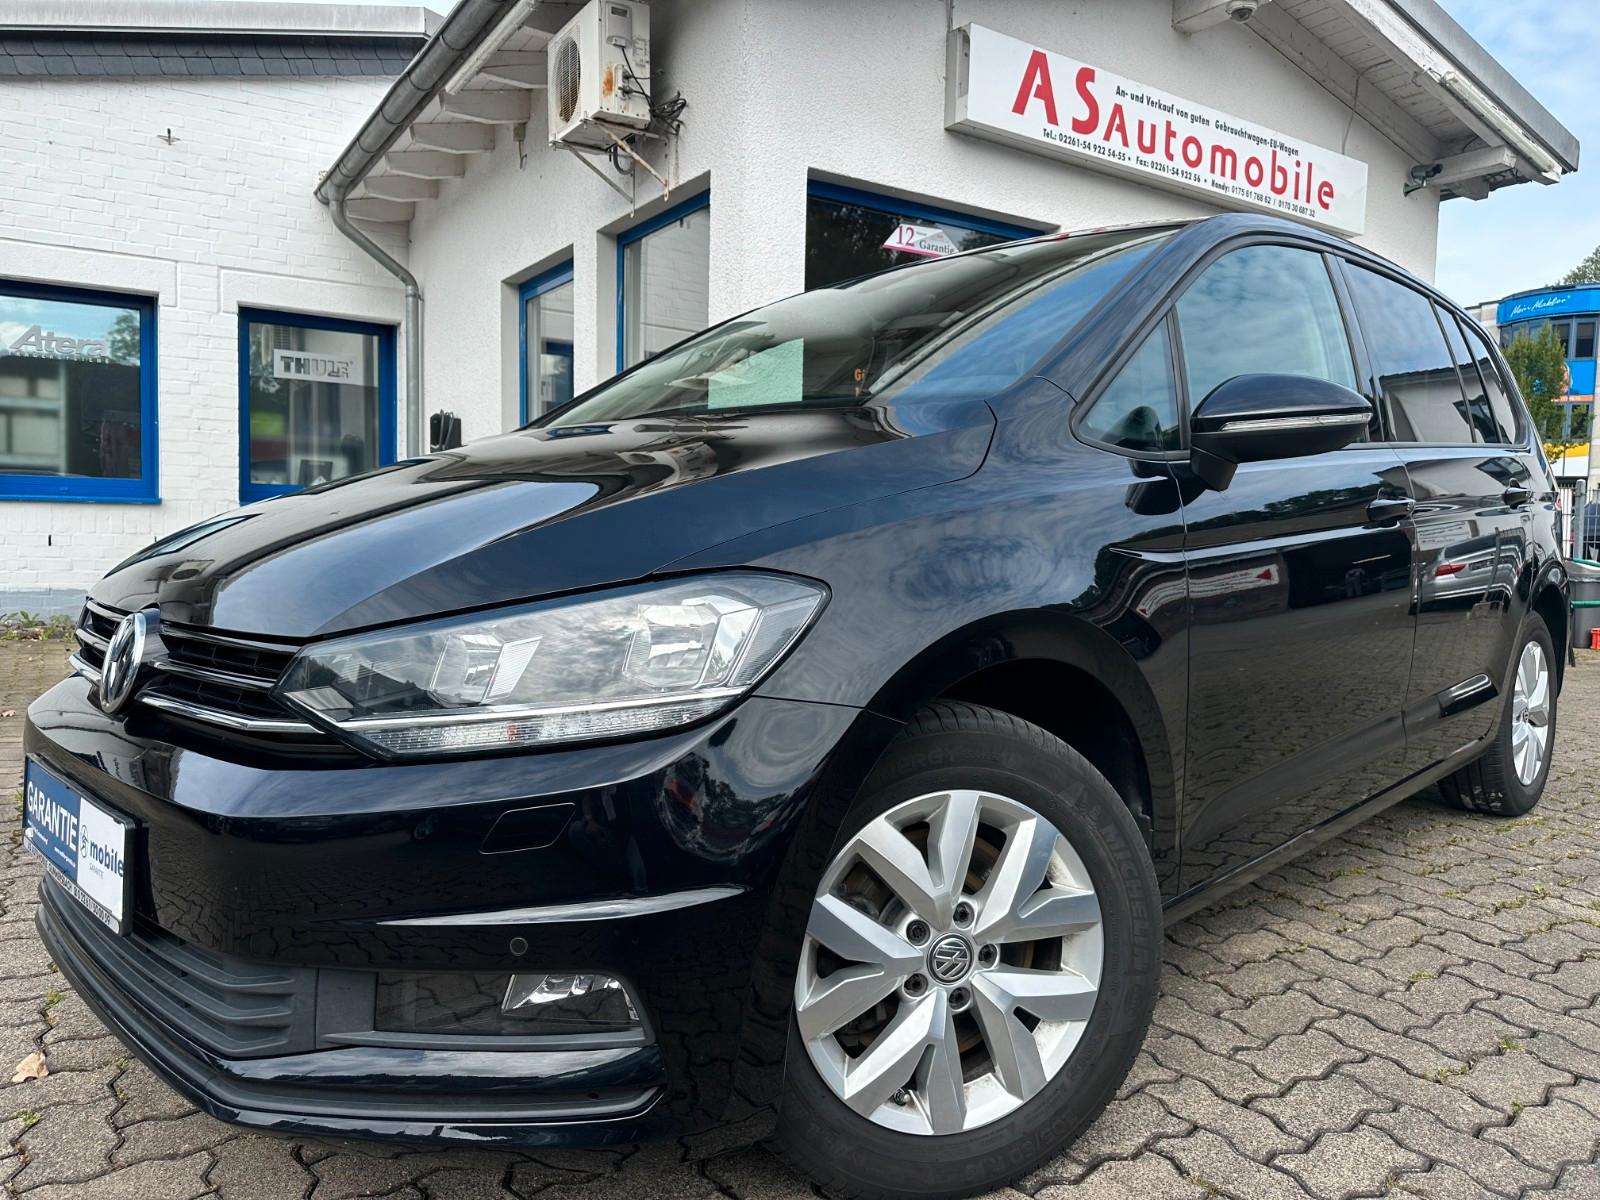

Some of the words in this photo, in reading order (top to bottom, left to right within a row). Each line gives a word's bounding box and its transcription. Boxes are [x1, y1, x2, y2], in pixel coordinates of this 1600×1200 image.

[1115, 85, 1128, 98] An-
[1130, 92, 1144, 104] und
[1146, 95, 1175, 114] Verkauf
[1176, 108, 1189, 120] von
[1190, 113, 1210, 126] guten
[1058, 133, 1092, 152] 02261-54
[1093, 144, 1106, 156] 922
[1107, 149, 1126, 162] 54-55
[1136, 156, 1149, 168] Fax:
[1150, 160, 1180, 176] 02261-54
[1181, 169, 1193, 181] 922
[1193, 173, 1201, 183] 56
[1211, 179, 1231, 193] Handy:
[1231, 185, 1245, 196] 0175
[1245, 189, 1253, 199] 61
[1291, 203, 1298, 212] 30
[1308, 207, 1316, 218] 32
[896, 225, 915, 247] 12
[919, 240, 955, 255] Garantie
[9, 325, 111, 357] Atera
[27, 781, 78, 852] GARANTIE
[89, 839, 124, 877] mobile
